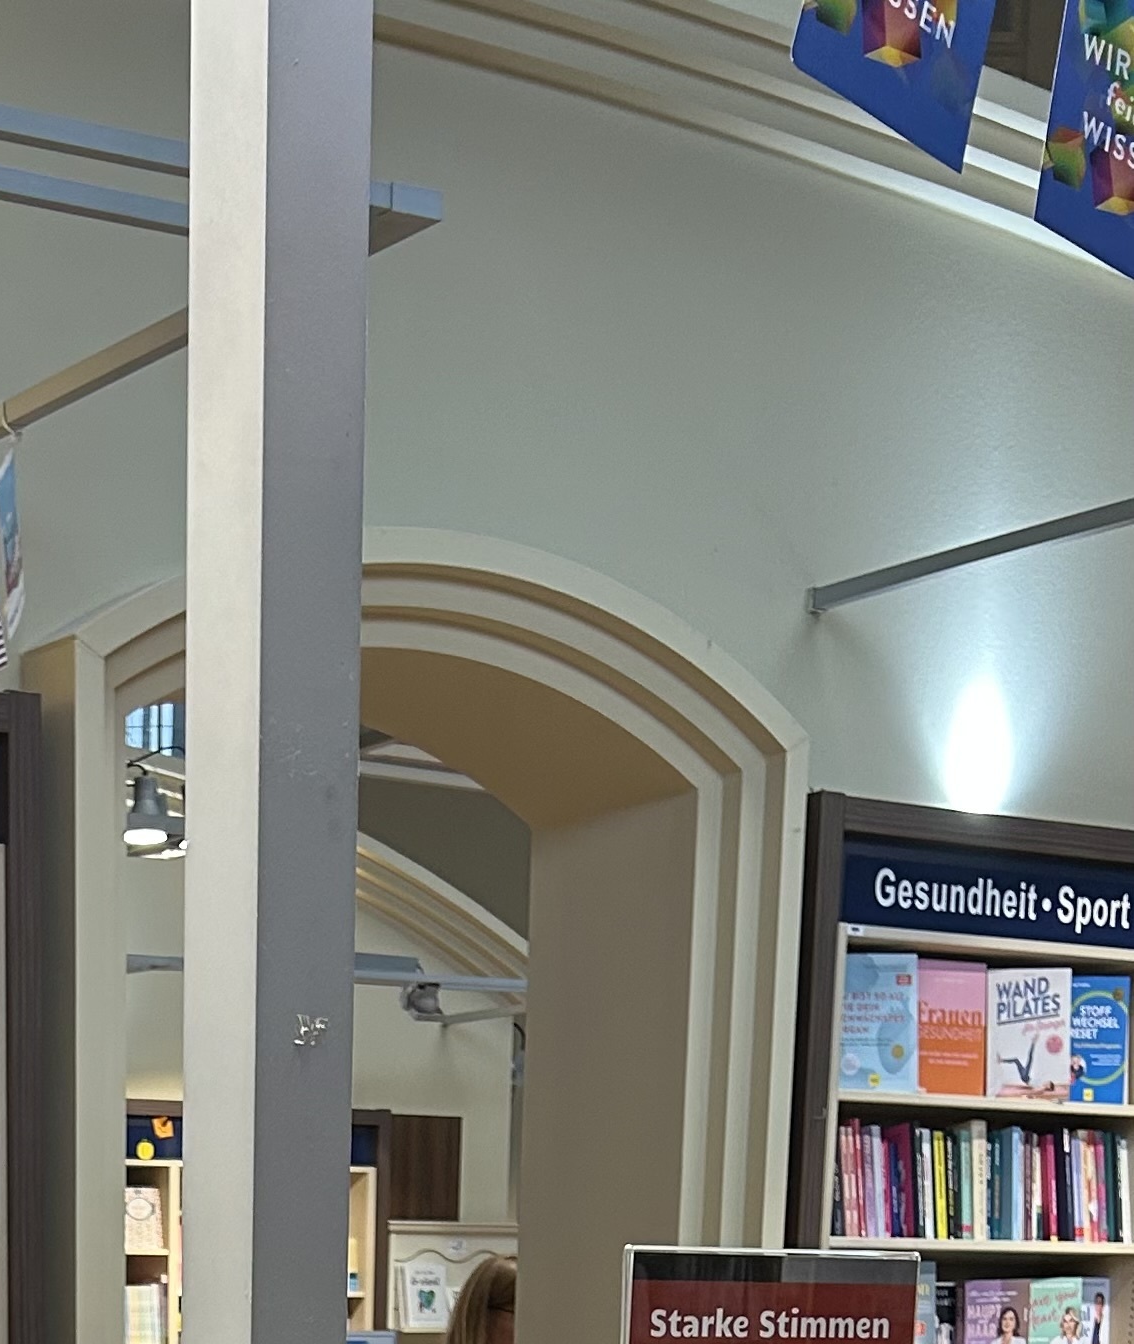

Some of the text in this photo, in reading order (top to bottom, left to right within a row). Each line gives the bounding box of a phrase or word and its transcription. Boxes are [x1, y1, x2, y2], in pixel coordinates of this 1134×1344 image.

[1082, 34, 1130, 81] WIR
[996, 977, 1050, 998] WAND
[996, 995, 1061, 1021] PILATES
[650, 1308, 891, 1340] Starke Stimmen
